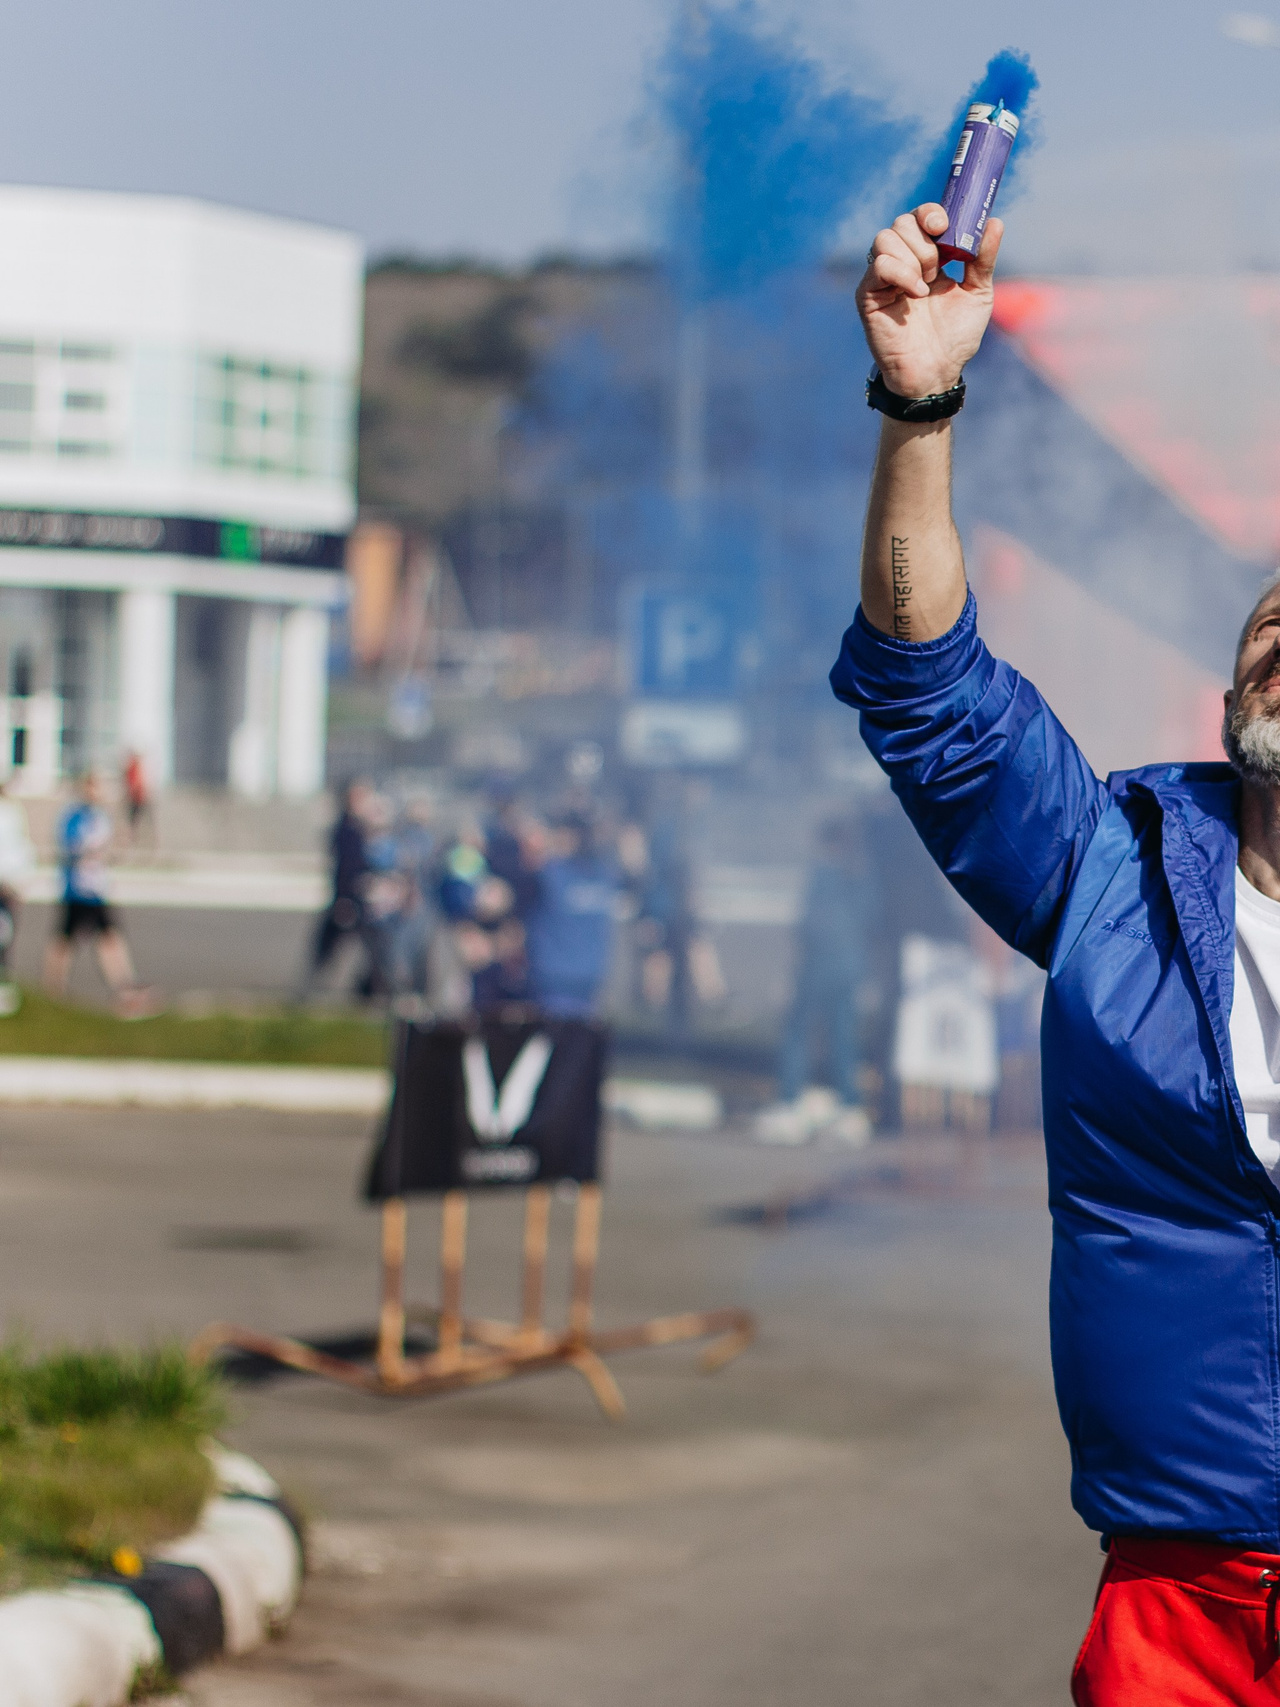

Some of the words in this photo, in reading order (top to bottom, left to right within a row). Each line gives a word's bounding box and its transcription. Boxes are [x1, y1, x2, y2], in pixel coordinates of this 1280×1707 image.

[976, 210, 987, 230] Blue
[983, 178, 997, 208] Sonata
[891, 535, 912, 610] महासागर
